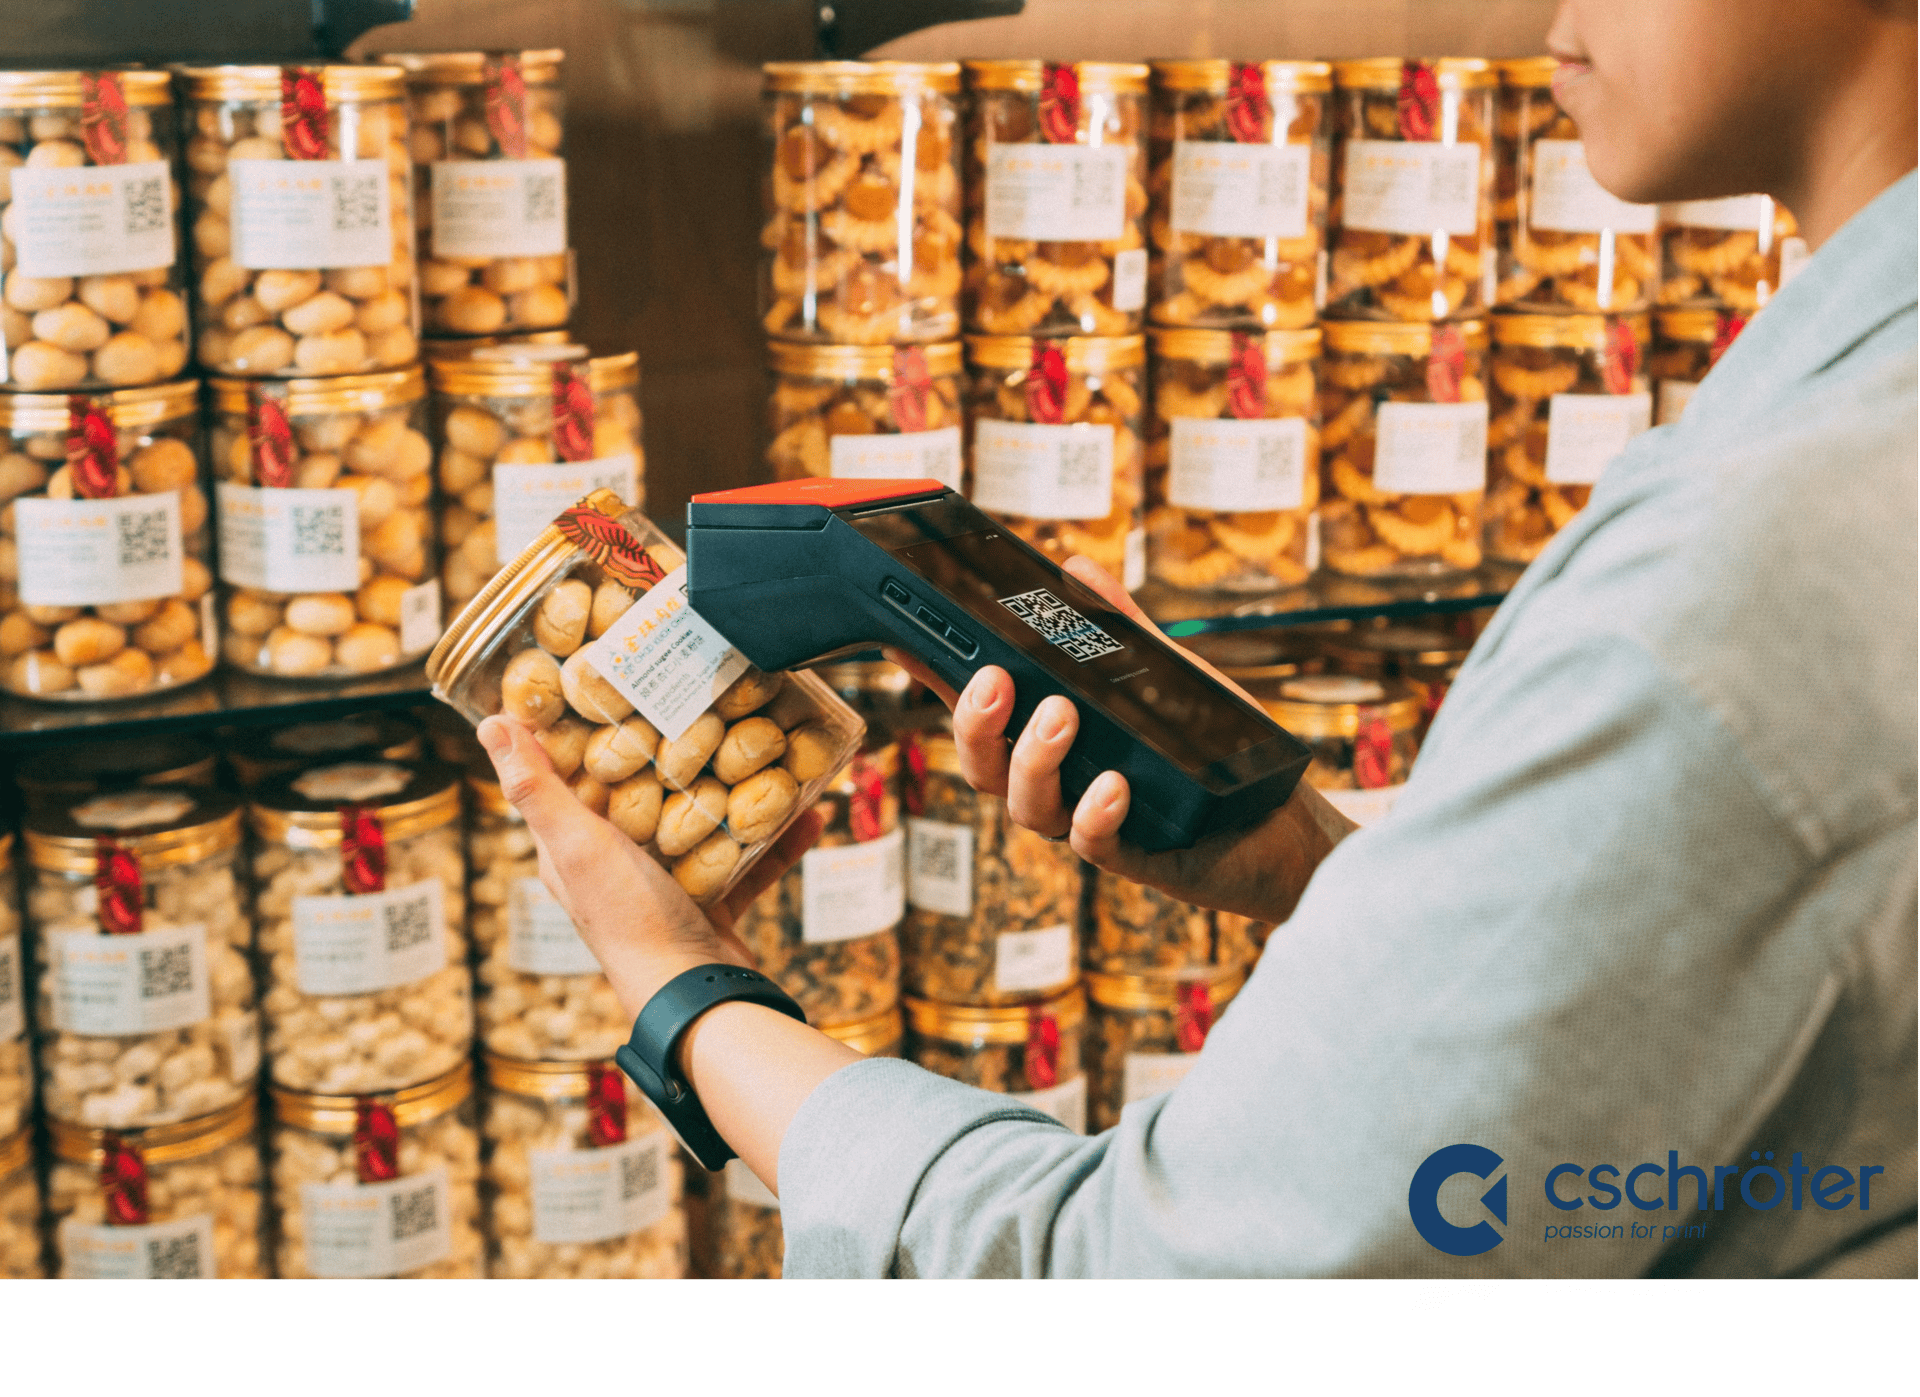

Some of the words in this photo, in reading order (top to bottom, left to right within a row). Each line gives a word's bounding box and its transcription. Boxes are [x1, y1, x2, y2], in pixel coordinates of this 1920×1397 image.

[631, 664, 655, 690] Almond
[654, 649, 672, 666] sugee
[671, 629, 693, 649] Cookies
